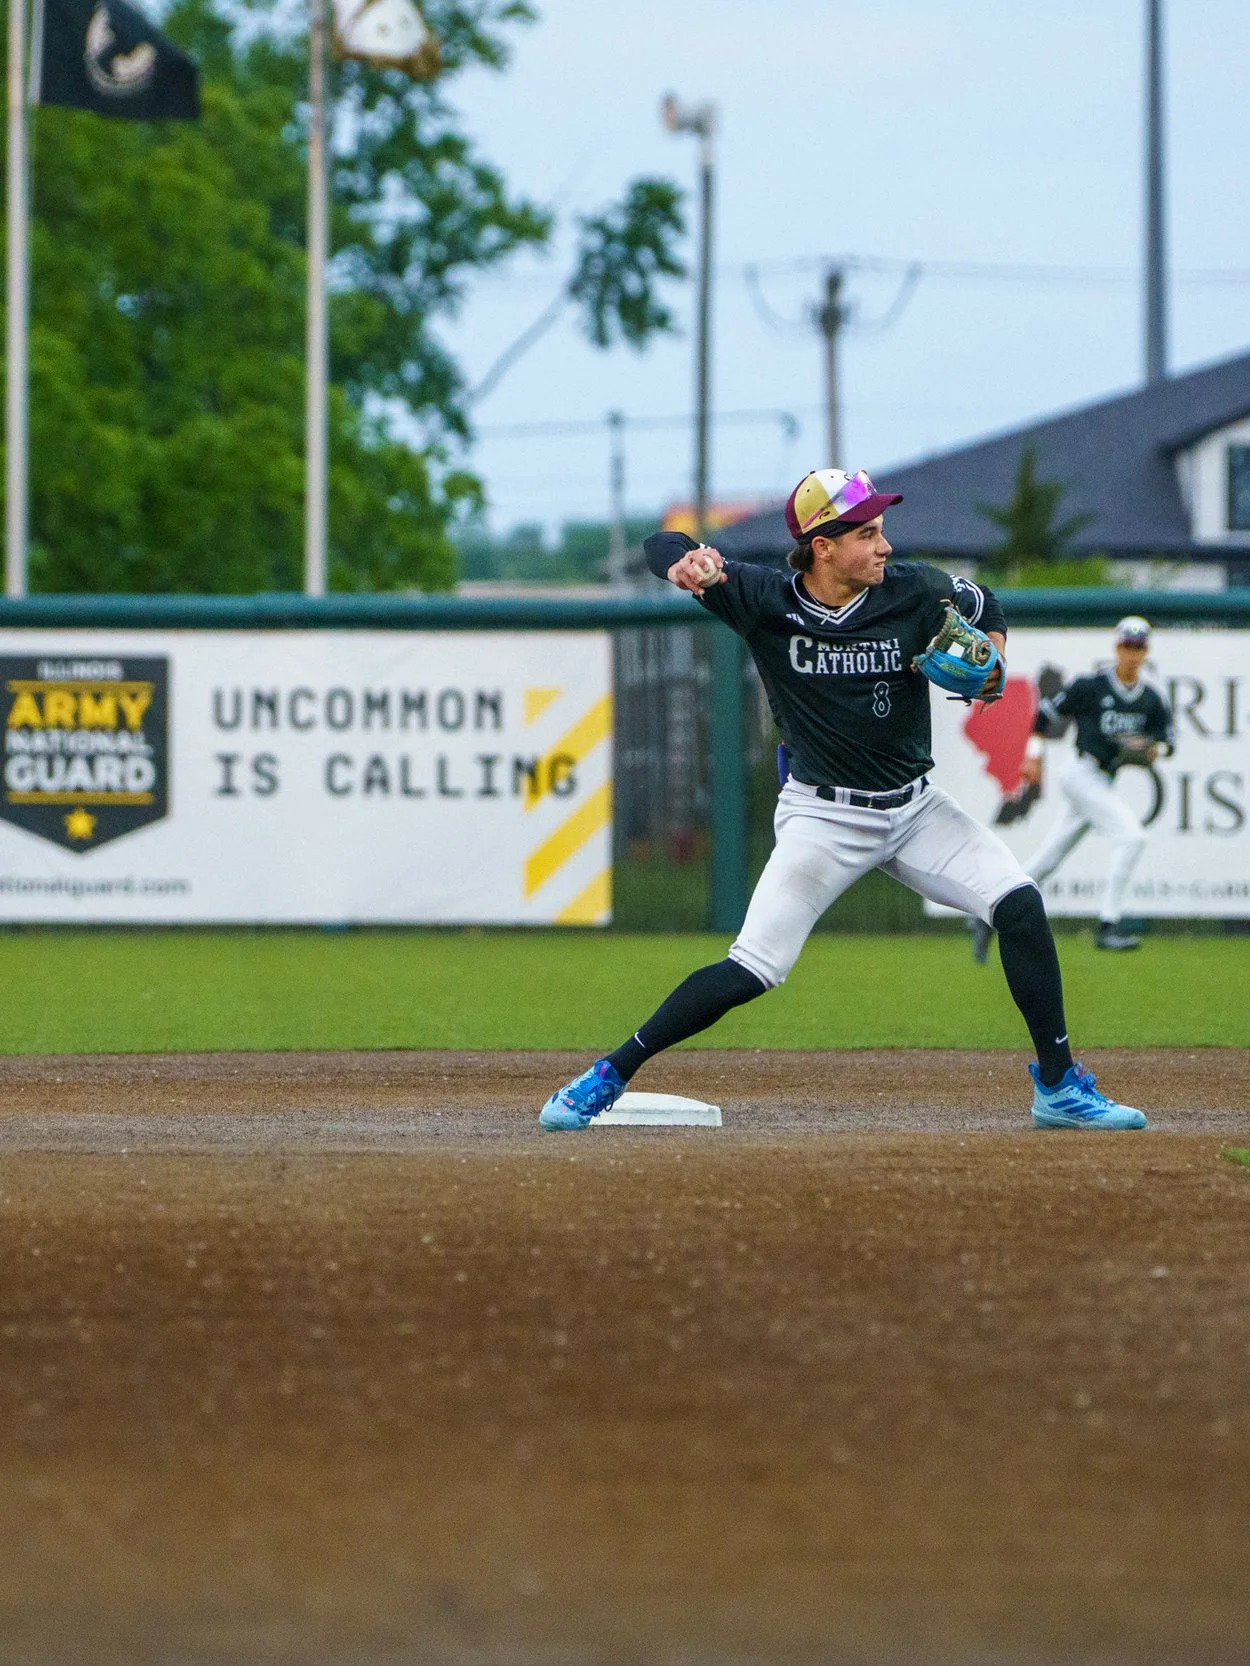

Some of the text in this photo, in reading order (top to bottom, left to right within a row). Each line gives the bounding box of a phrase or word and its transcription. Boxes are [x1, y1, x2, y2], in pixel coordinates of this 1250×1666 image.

[6, 689, 153, 730] ARMY
[212, 687, 503, 730] UNCOMMON
[872, 681, 892, 718] 8
[6, 730, 152, 755] NATIONAL
[5, 754, 155, 791] GUARD
[214, 754, 579, 796] IS CALLING
